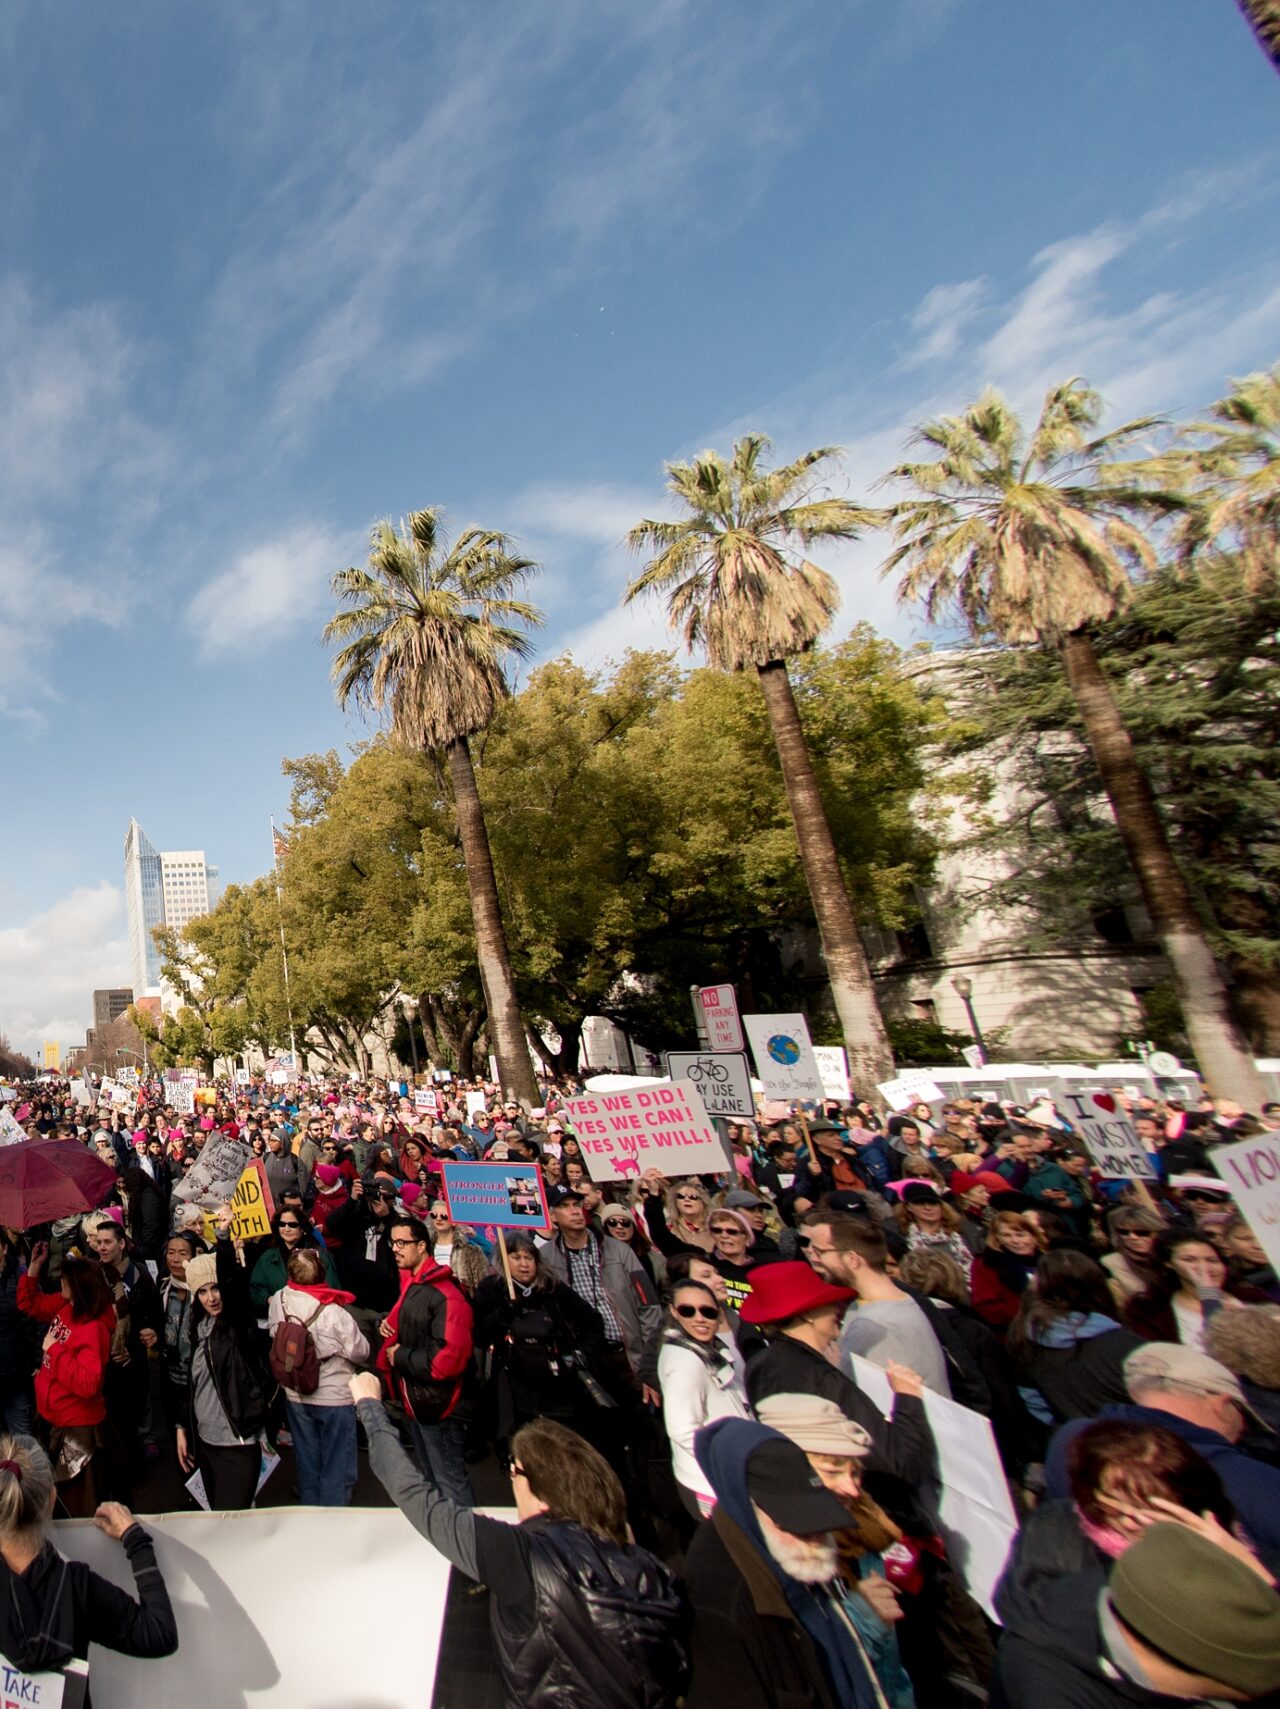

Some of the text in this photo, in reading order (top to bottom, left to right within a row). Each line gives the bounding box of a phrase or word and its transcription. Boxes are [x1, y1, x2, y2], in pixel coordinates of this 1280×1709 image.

[703, 992, 719, 1007] NO
[706, 1006, 734, 1018] PARKING
[715, 1020, 730, 1030] ANY
[716, 1033, 734, 1043] TIME
[167, 1082, 193, 1091] VETERANS
[712, 1084, 735, 1097] USE
[566, 1100, 598, 1115] YES
[602, 1095, 633, 1111] WE
[715, 1099, 745, 1112] LANE
[1065, 1094, 1094, 1119] I
[573, 1120, 607, 1135] YES
[610, 1114, 642, 1131] WE
[580, 1138, 614, 1154] YES
[617, 1132, 650, 1151] WE
[448, 1181, 505, 1191] STRONGER
[452, 1195, 507, 1206] TOGETHER
[208, 1215, 264, 1237] TUTH
[2, 1666, 41, 1705] TAKE
